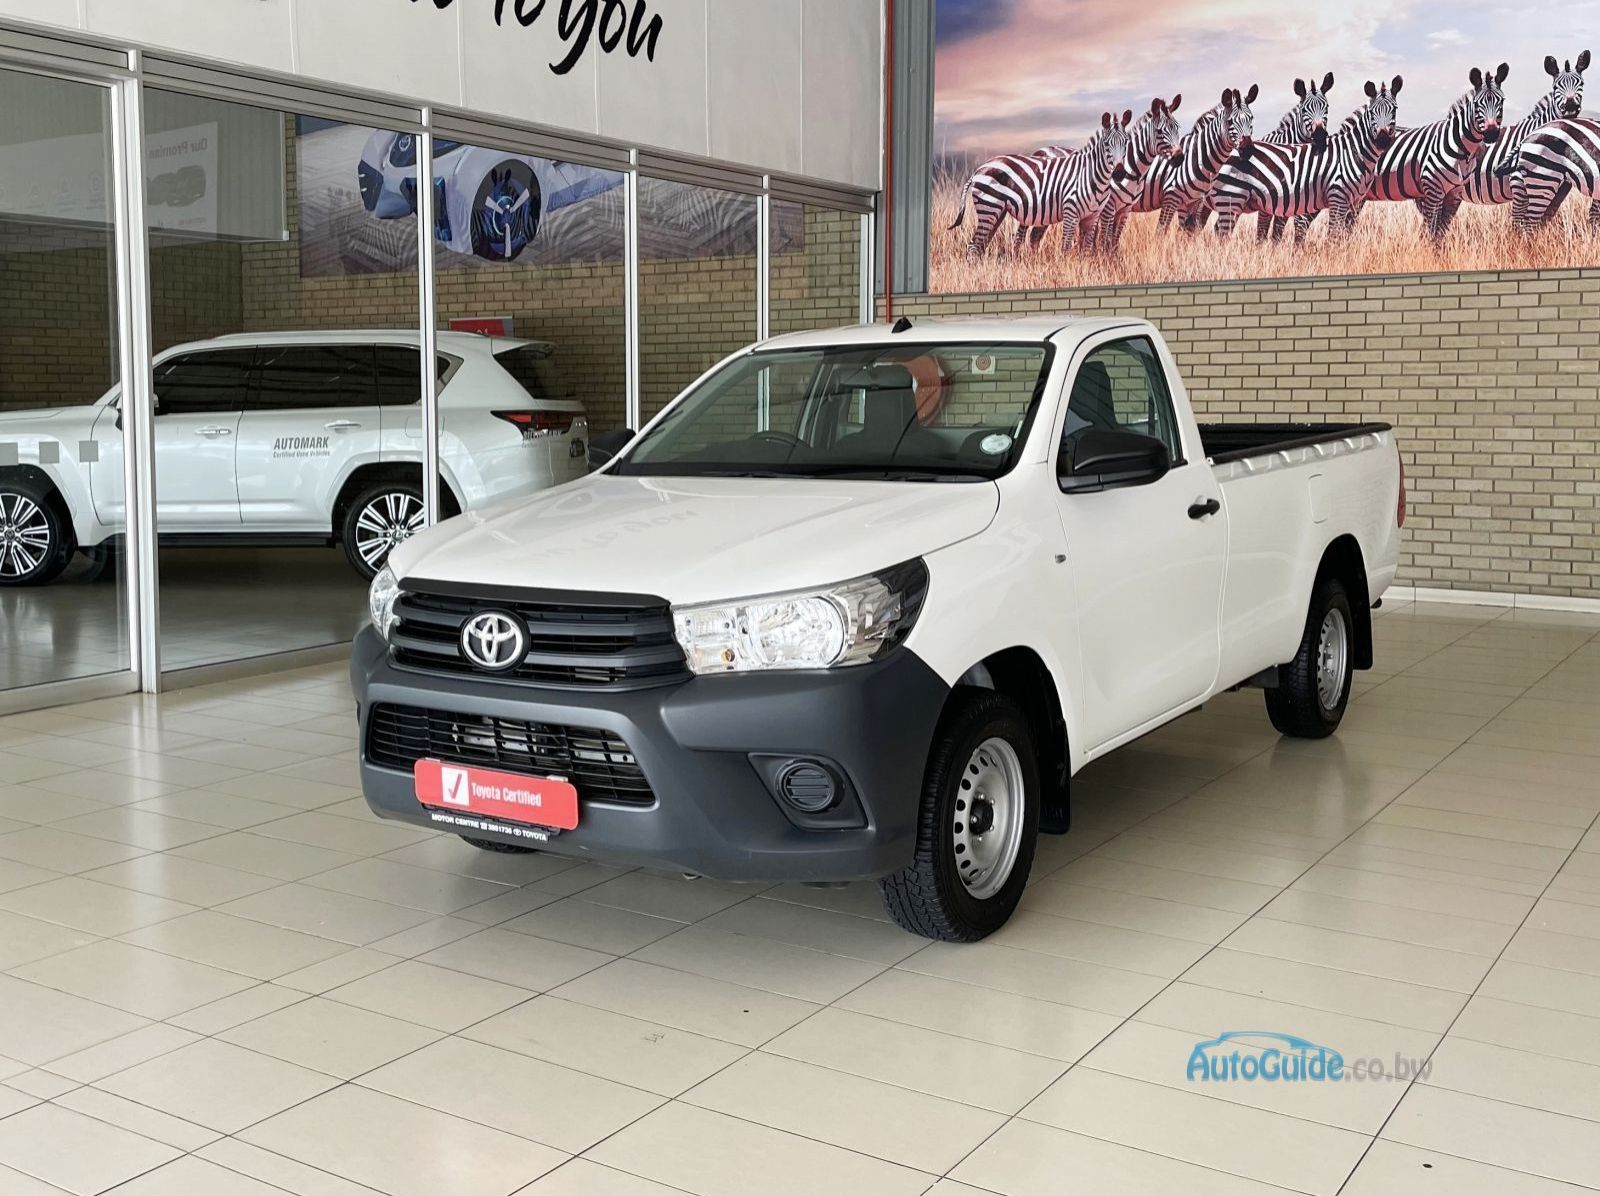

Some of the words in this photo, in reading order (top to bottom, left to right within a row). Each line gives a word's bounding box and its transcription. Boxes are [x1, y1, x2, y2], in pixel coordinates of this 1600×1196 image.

[548, 0, 663, 75] you
[273, 436, 330, 450] AUTOMARK
[471, 782, 500, 800] Toyota
[502, 788, 542, 807] Certified
[431, 813, 455, 823] MOTOR
[455, 816, 479, 828] CENTRE
[522, 829, 547, 841] TOYOTA
